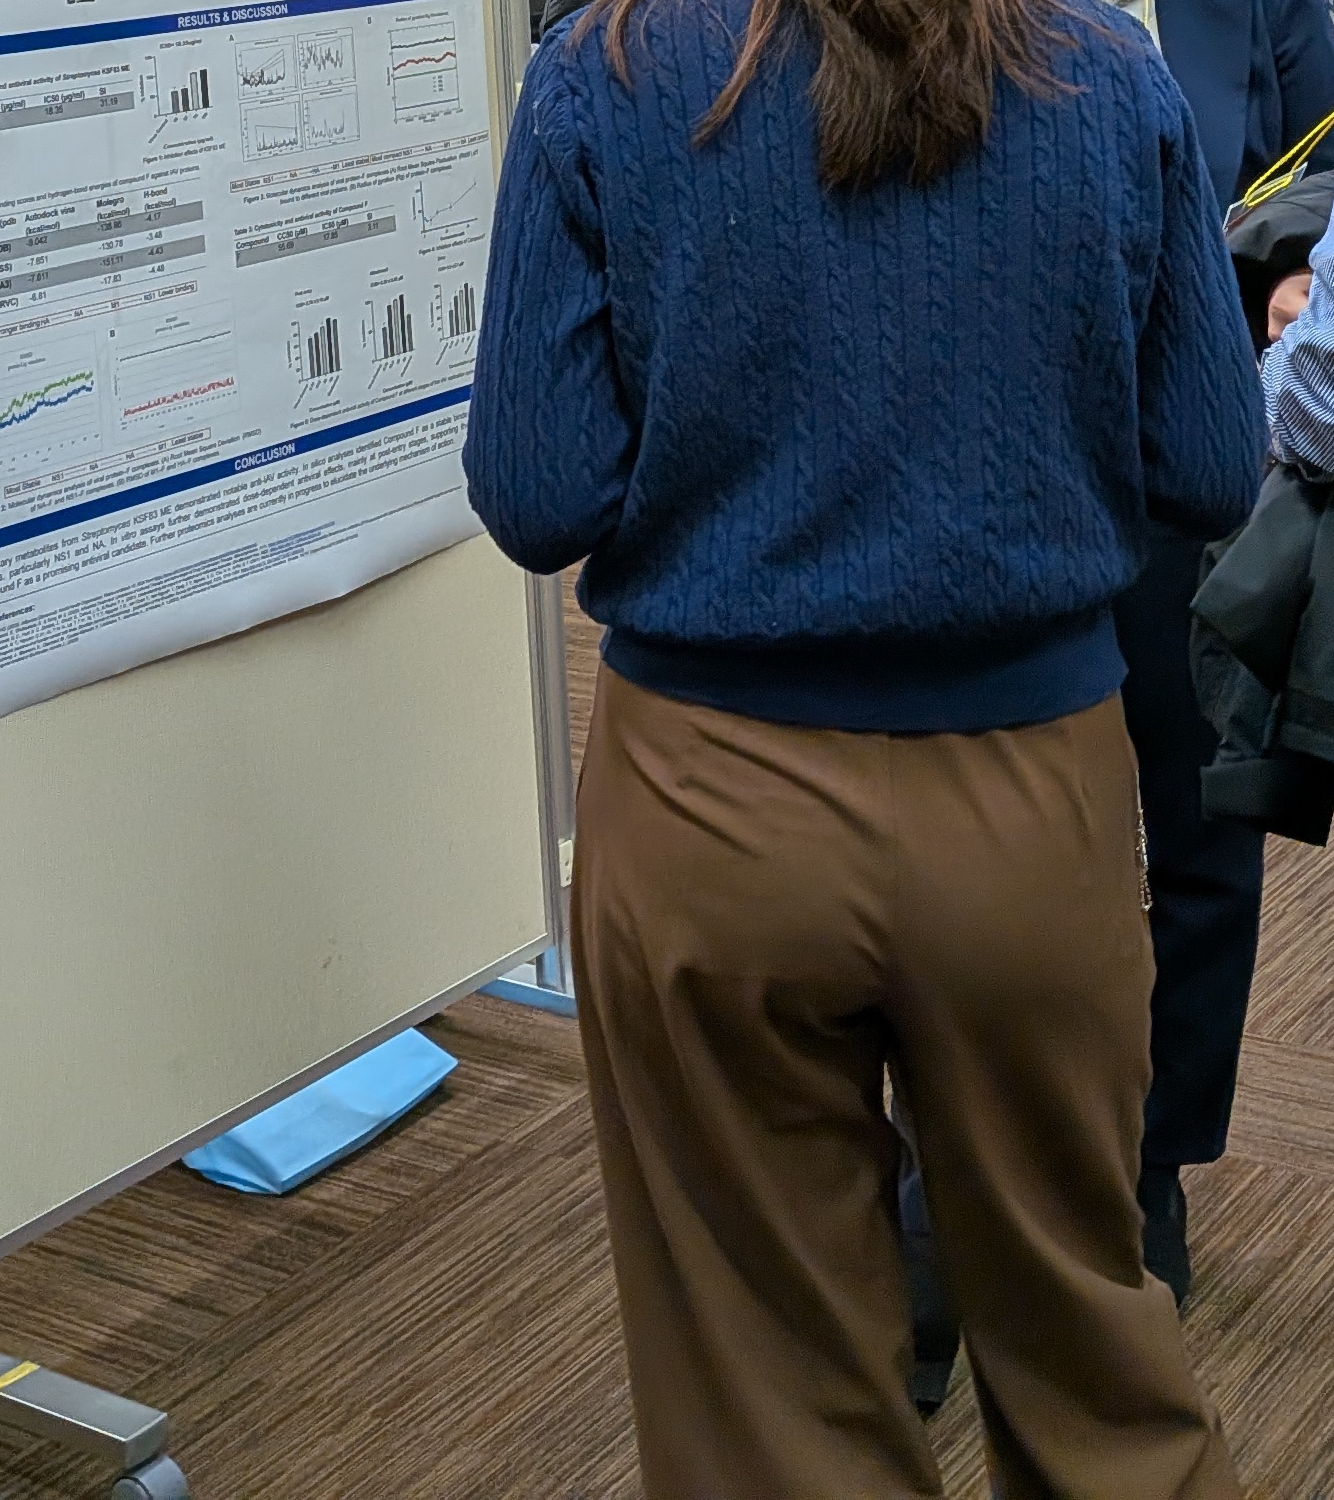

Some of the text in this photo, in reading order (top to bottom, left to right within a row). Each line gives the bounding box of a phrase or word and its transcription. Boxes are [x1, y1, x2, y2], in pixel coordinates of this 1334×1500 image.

[178, 4, 288, 27] RESULTS & DISCUSSION
[44, 94, 59, 103] IC50
[235, 443, 295, 470] CONCLUSION
[15, 543, 58, 562] metabolites
[62, 537, 79, 548] from
[82, 517, 130, 542] Streptomyces
[160, 505, 172, 516] ME
[175, 491, 220, 512] demonstrated
[223, 483, 247, 496] notable
[303, 463, 308, 471] In
[311, 458, 326, 469] silico
[328, 449, 353, 462] analyses
[356, 440, 381, 453] identified
[383, 428, 414, 445] Compound
[416, 426, 419, 434] F
[436, 417, 451, 427] stable
